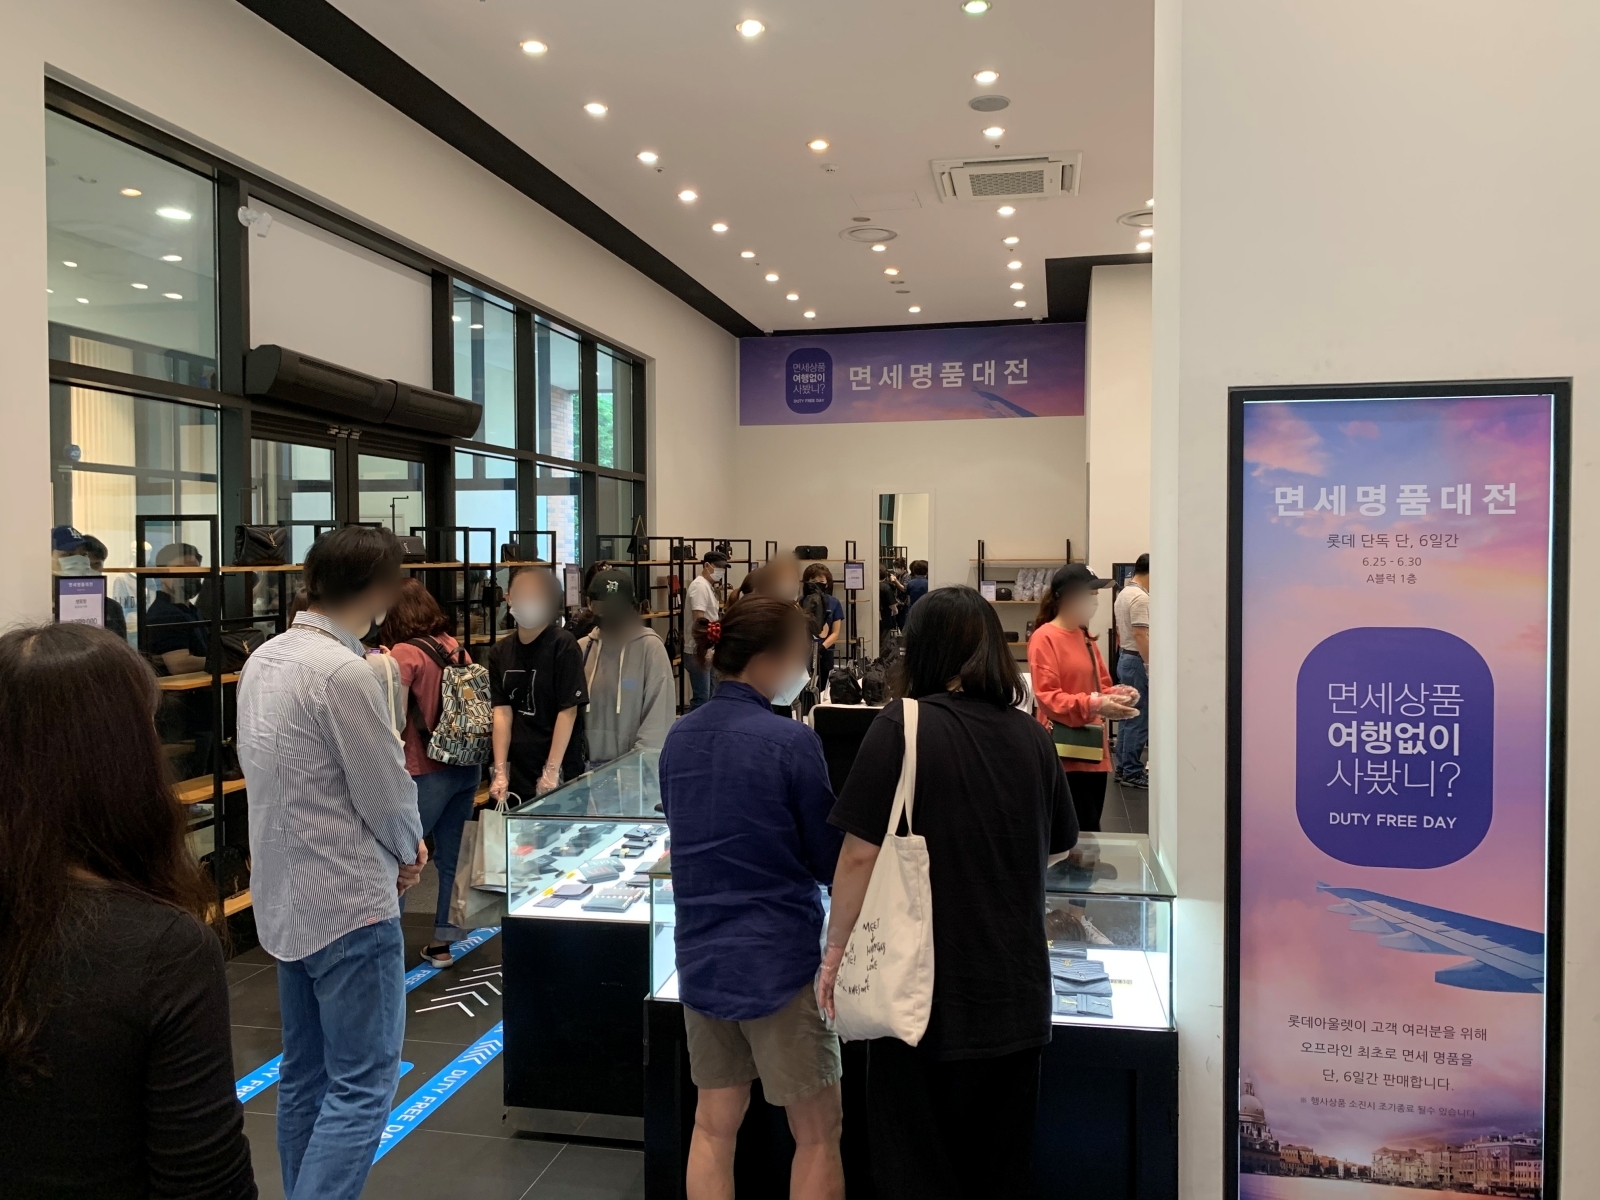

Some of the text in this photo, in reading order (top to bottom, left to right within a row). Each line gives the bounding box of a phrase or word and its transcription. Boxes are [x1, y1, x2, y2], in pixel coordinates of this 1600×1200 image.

[793, 362, 826, 373] 면세상품
[793, 372, 825, 383] 여행없이
[849, 358, 1030, 391] 면세명품대전
[793, 383, 826, 395] 사봤니?
[1274, 482, 1518, 517] 면세명품대전
[1326, 533, 1459, 550] 롯데 단독 단, 6일간
[1362, 556, 1387, 567] 6.25
[1397, 556, 1422, 567] 6.30
[1366, 572, 1417, 585] A블럭 1층
[1328, 681, 1465, 717] 면세상품
[1328, 720, 1460, 756] 여행없이
[1326, 758, 1461, 798] 사봤니?
[1329, 812, 1457, 829] DUTY FREE DAY
[1288, 1014, 1487, 1041] 롯데아울렛이 고객 여러분을 위해
[1300, 1041, 1474, 1067] 오프라인 최초로 면세 명품을
[431, 1069, 468, 1094] DUTY
[1322, 1069, 1454, 1091] 단, 6일간 판매합니다.
[396, 1096, 437, 1122] FREE
[1311, 1096, 1346, 1108] 행사상품
[1349, 1100, 1376, 1111] 소진시
[1378, 1102, 1414, 1113] 조기종료
